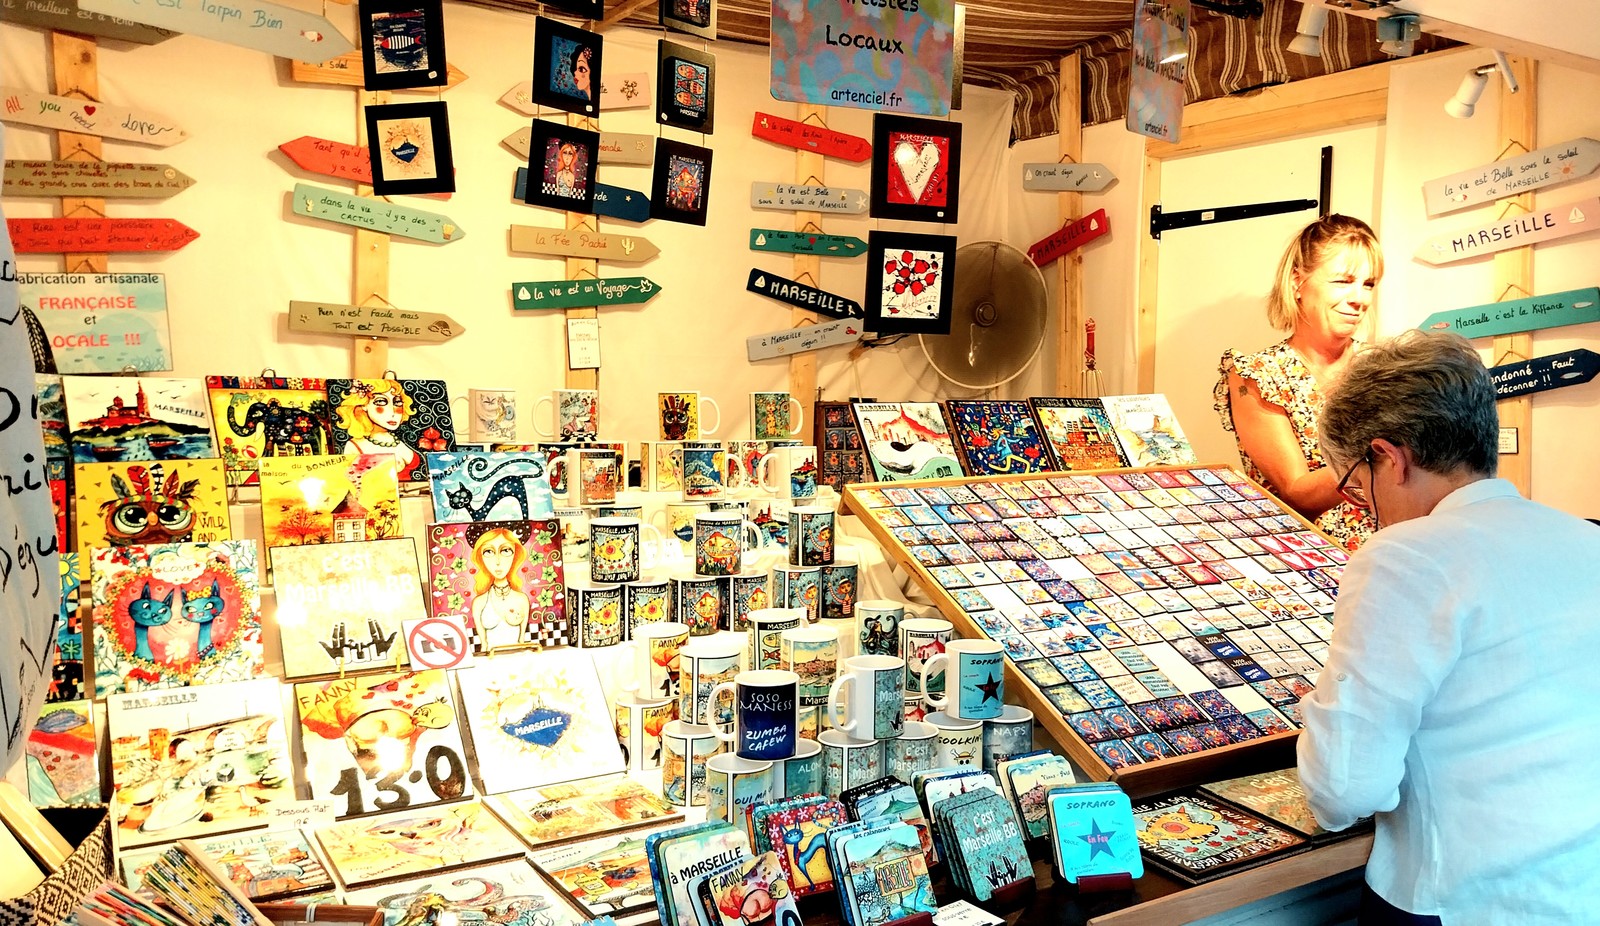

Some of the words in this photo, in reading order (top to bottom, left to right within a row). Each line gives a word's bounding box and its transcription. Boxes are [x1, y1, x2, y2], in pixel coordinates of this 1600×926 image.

[77, 11, 93, 20] est
[249, 9, 283, 29] Bien
[826, 24, 904, 54] Locaux
[831, 87, 903, 107] artenciel.fr
[6, 96, 24, 114] All
[40, 100, 61, 115] you
[121, 113, 174, 136] Love
[313, 140, 334, 153] Tant
[1444, 184, 1454, 197] la
[1474, 174, 1489, 187] est
[1491, 166, 1514, 184] Belle
[1520, 161, 1538, 173] sous
[1542, 155, 1551, 164] le
[1486, 186, 1497, 196] de
[1505, 171, 1550, 192] MARSEILLE
[776, 184, 783, 194] la
[800, 188, 810, 196] est
[815, 187, 829, 197] Belle
[320, 196, 343, 209] dans
[347, 199, 356, 210] la
[411, 215, 427, 226] des
[340, 212, 376, 226] CACTUS
[536, 233, 545, 245] la
[551, 234, 570, 246] Fée
[1036, 221, 1087, 259] MARSEILLE
[1452, 212, 1557, 253] MARSEILLE
[19, 272, 86, 285] abrication
[95, 272, 159, 284] artisanale
[534, 288, 545, 300] la
[549, 284, 562, 297] vie
[568, 282, 580, 294] est
[596, 279, 628, 299] Voyage
[770, 282, 844, 313] MARSEILLE
[39, 296, 137, 312] FRANÇAISE
[84, 314, 97, 325] et
[340, 308, 362, 317] n'est
[400, 312, 419, 320] mais
[1455, 312, 1491, 330] Marseille
[1495, 308, 1515, 321] c'est
[1519, 305, 1529, 316] la
[1532, 300, 1565, 315] Kiffance
[357, 322, 374, 332] est
[50, 334, 110, 348] OCALE
[770, 331, 802, 346] MARSEILLE
[1552, 356, 1576, 371] Faut
[1497, 377, 1539, 395] déconner
[154, 402, 206, 419] MARSEILLE
[306, 455, 348, 472] BONHEUR
[198, 515, 225, 530] WILD
[198, 532, 216, 543] AND
[163, 564, 194, 573] LOVE
[321, 550, 370, 574] c'est
[386, 573, 416, 595] BB
[652, 639, 679, 650] FANNY
[299, 677, 359, 710] FANNY
[750, 692, 780, 703] SOSO
[740, 699, 792, 712] MANESS
[514, 716, 564, 736] MARSEILLE
[745, 724, 787, 740] ZUMBA
[993, 726, 1027, 737] NAPS
[748, 734, 787, 751] CAFEW
[1250, 774, 1295, 790] c'est
[735, 796, 752, 805] OUI
[1067, 799, 1116, 810] SOPRANO
[275, 806, 309, 817] Dessous
[973, 810, 994, 828] c'est
[962, 829, 1003, 854] Marseille
[1003, 821, 1018, 840] BB
[671, 873, 679, 885] à
[679, 846, 743, 882] MARSEILLE
[711, 866, 746, 894] FANNY
